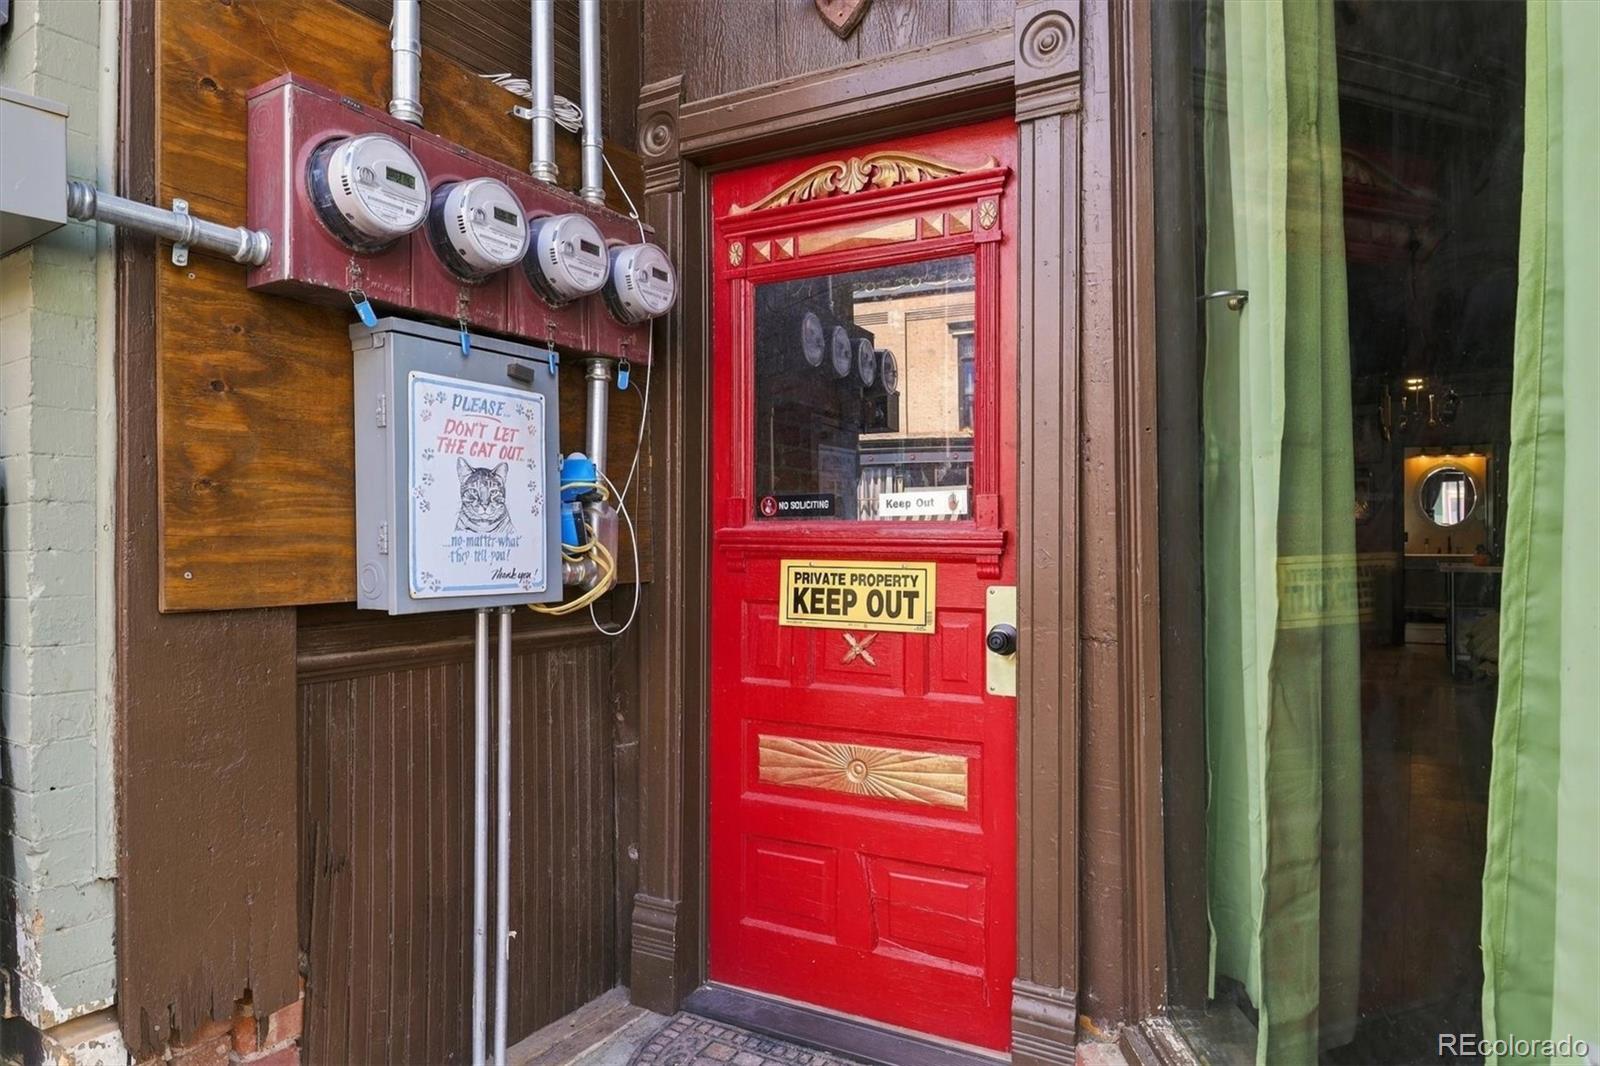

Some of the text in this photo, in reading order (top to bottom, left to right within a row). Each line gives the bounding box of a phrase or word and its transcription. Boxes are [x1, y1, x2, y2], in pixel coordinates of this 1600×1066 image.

[443, 418, 520, 443] DON'T LET
[437, 436, 467, 455] THE
[469, 440, 497, 459] CAT
[778, 499, 830, 511] NO SOLICITING
[885, 497, 935, 511] Keep Out
[474, 548, 488, 562] tell
[491, 567, 517, 580] Thank
[793, 571, 919, 588] PRIVATE PROPERTY
[792, 586, 858, 616] KEEP
[866, 588, 920, 620] OUT
